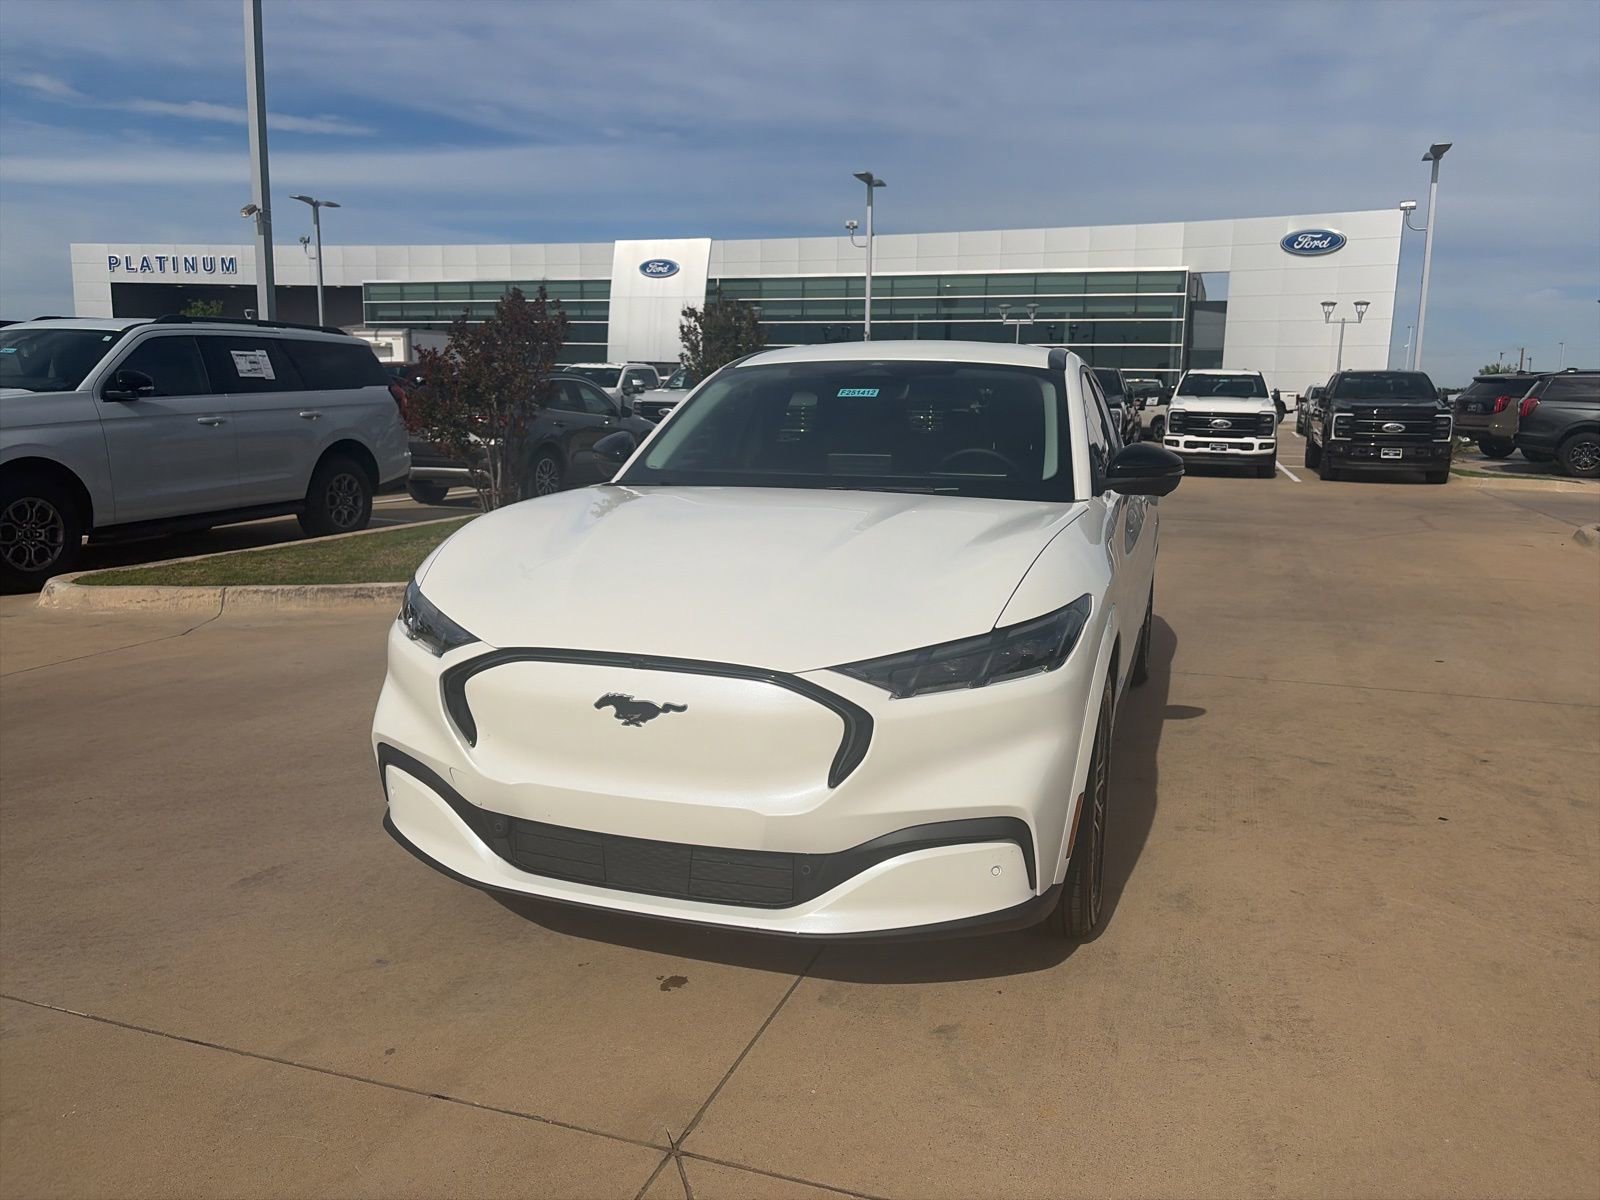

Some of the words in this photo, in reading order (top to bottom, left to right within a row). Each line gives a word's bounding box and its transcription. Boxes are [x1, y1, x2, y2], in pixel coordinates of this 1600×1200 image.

[1293, 233, 1332, 249] Ford
[107, 254, 237, 274] PLATINUM
[646, 261, 670, 273] Ford
